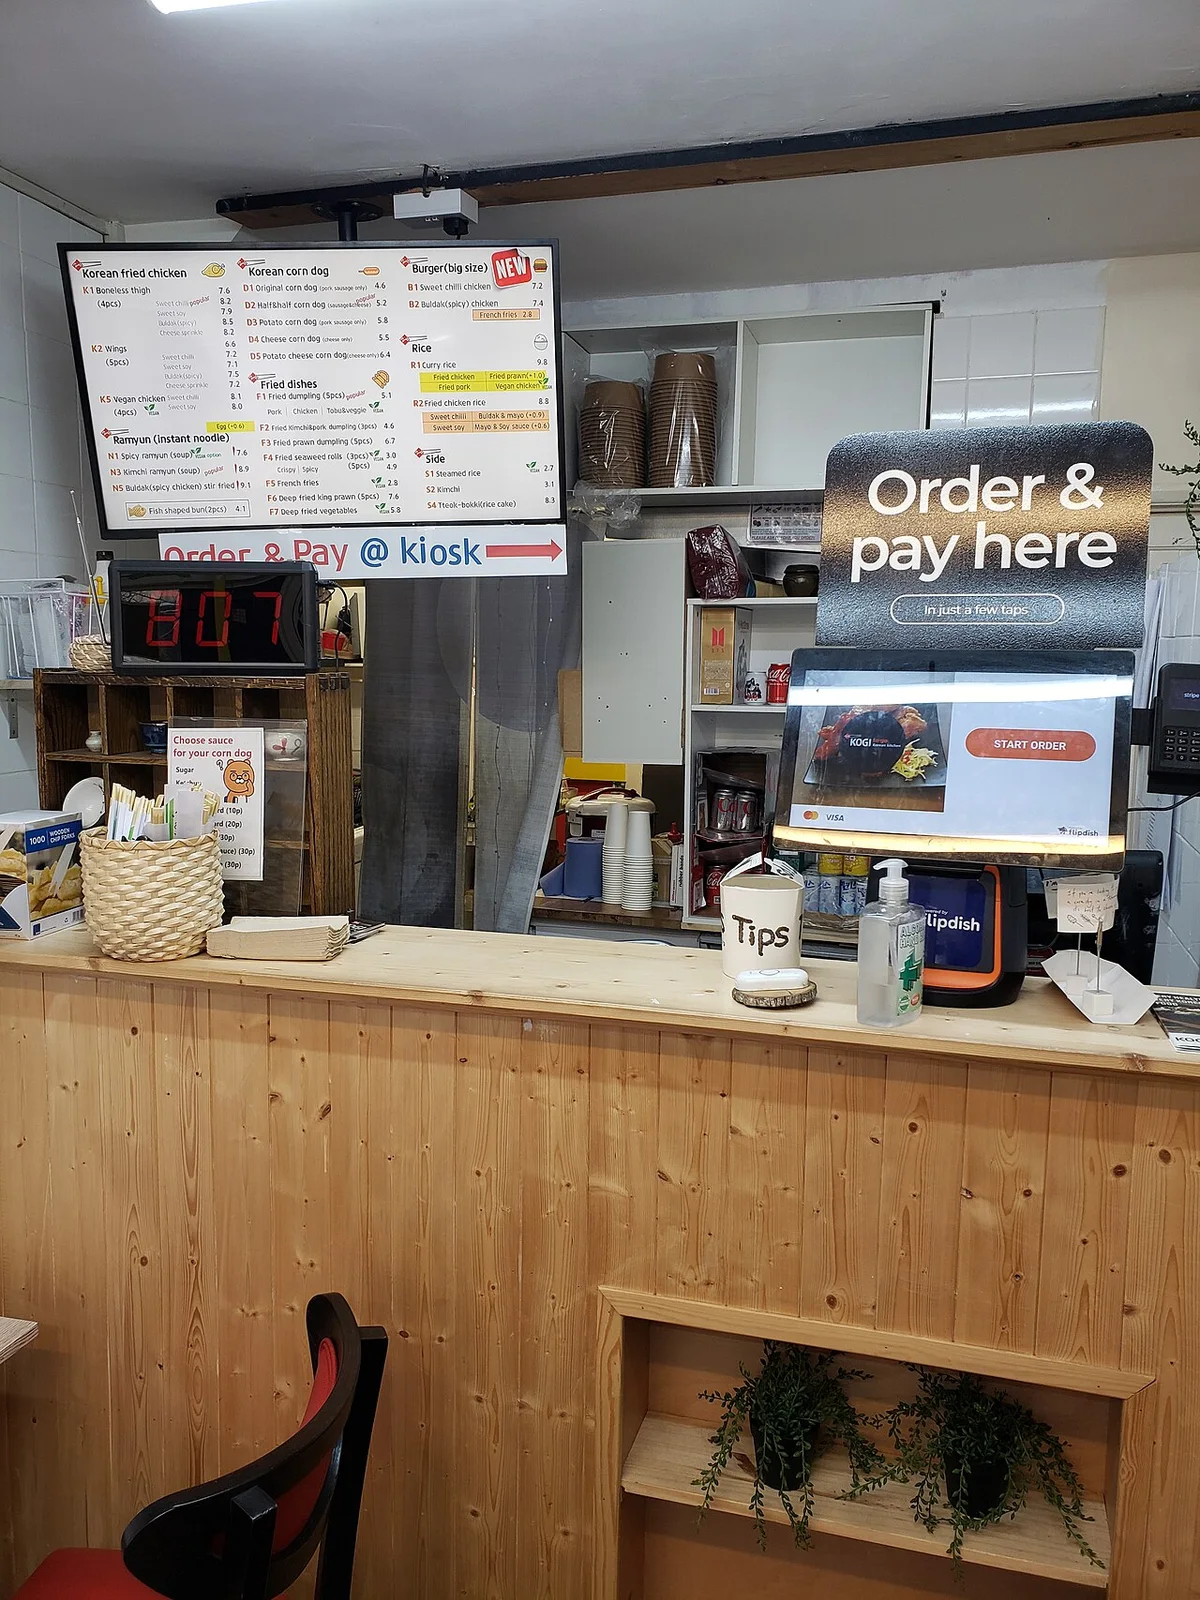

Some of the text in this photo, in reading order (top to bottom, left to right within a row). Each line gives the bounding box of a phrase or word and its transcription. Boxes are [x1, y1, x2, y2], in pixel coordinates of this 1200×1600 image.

[249, 267, 329, 277] Korean corn dog
[412, 263, 488, 274] Burger(big size)
[496, 256, 527, 280] NEW
[82, 268, 187, 279] Korean fried chicken
[131, 286, 151, 295] thigh
[256, 285, 283, 293] Original
[304, 284, 317, 292] dog
[97, 300, 122, 308] (4pcs)
[312, 301, 326, 309] dog
[304, 318, 317, 327] dog
[307, 335, 320, 344] dog
[91, 345, 128, 354] K2 Wings
[412, 344, 432, 353] Rice
[422, 361, 441, 369] Curry
[442, 361, 456, 369] rice
[261, 380, 317, 389] Fried dishes
[113, 395, 137, 404] Vegan
[138, 395, 166, 403] chicken
[289, 392, 321, 400] dumpling
[322, 392, 345, 400] (5pcs)
[113, 434, 230, 446] Ramyun (instant noodle)
[121, 452, 140, 460] Spicy
[170, 451, 193, 459] (soup)
[426, 455, 445, 463] Side
[124, 468, 148, 476] Kimchi
[177, 467, 201, 475] (soup)
[126, 484, 170, 492] Buldak(spicy
[172, 483, 202, 491] chicken)
[868, 462, 1104, 516] Order &
[165, 507, 190, 515] shaped
[192, 506, 227, 514] bun(2pcs)
[281, 508, 299, 516] Deep
[320, 507, 358, 515] vegetables
[164, 537, 483, 572] Order & Pay @ kiosk
[850, 521, 1118, 583] pay here
[924, 604, 1028, 618] In just a few taps
[173, 736, 206, 745] Choose
[850, 738, 871, 747] KOGI
[994, 740, 1066, 751] START ORDER
[173, 749, 187, 757] for
[188, 750, 210, 759] your
[235, 749, 252, 759] dog
[826, 813, 845, 822] VISA
[29, 836, 46, 845] 1000
[732, 914, 790, 956] Tips
